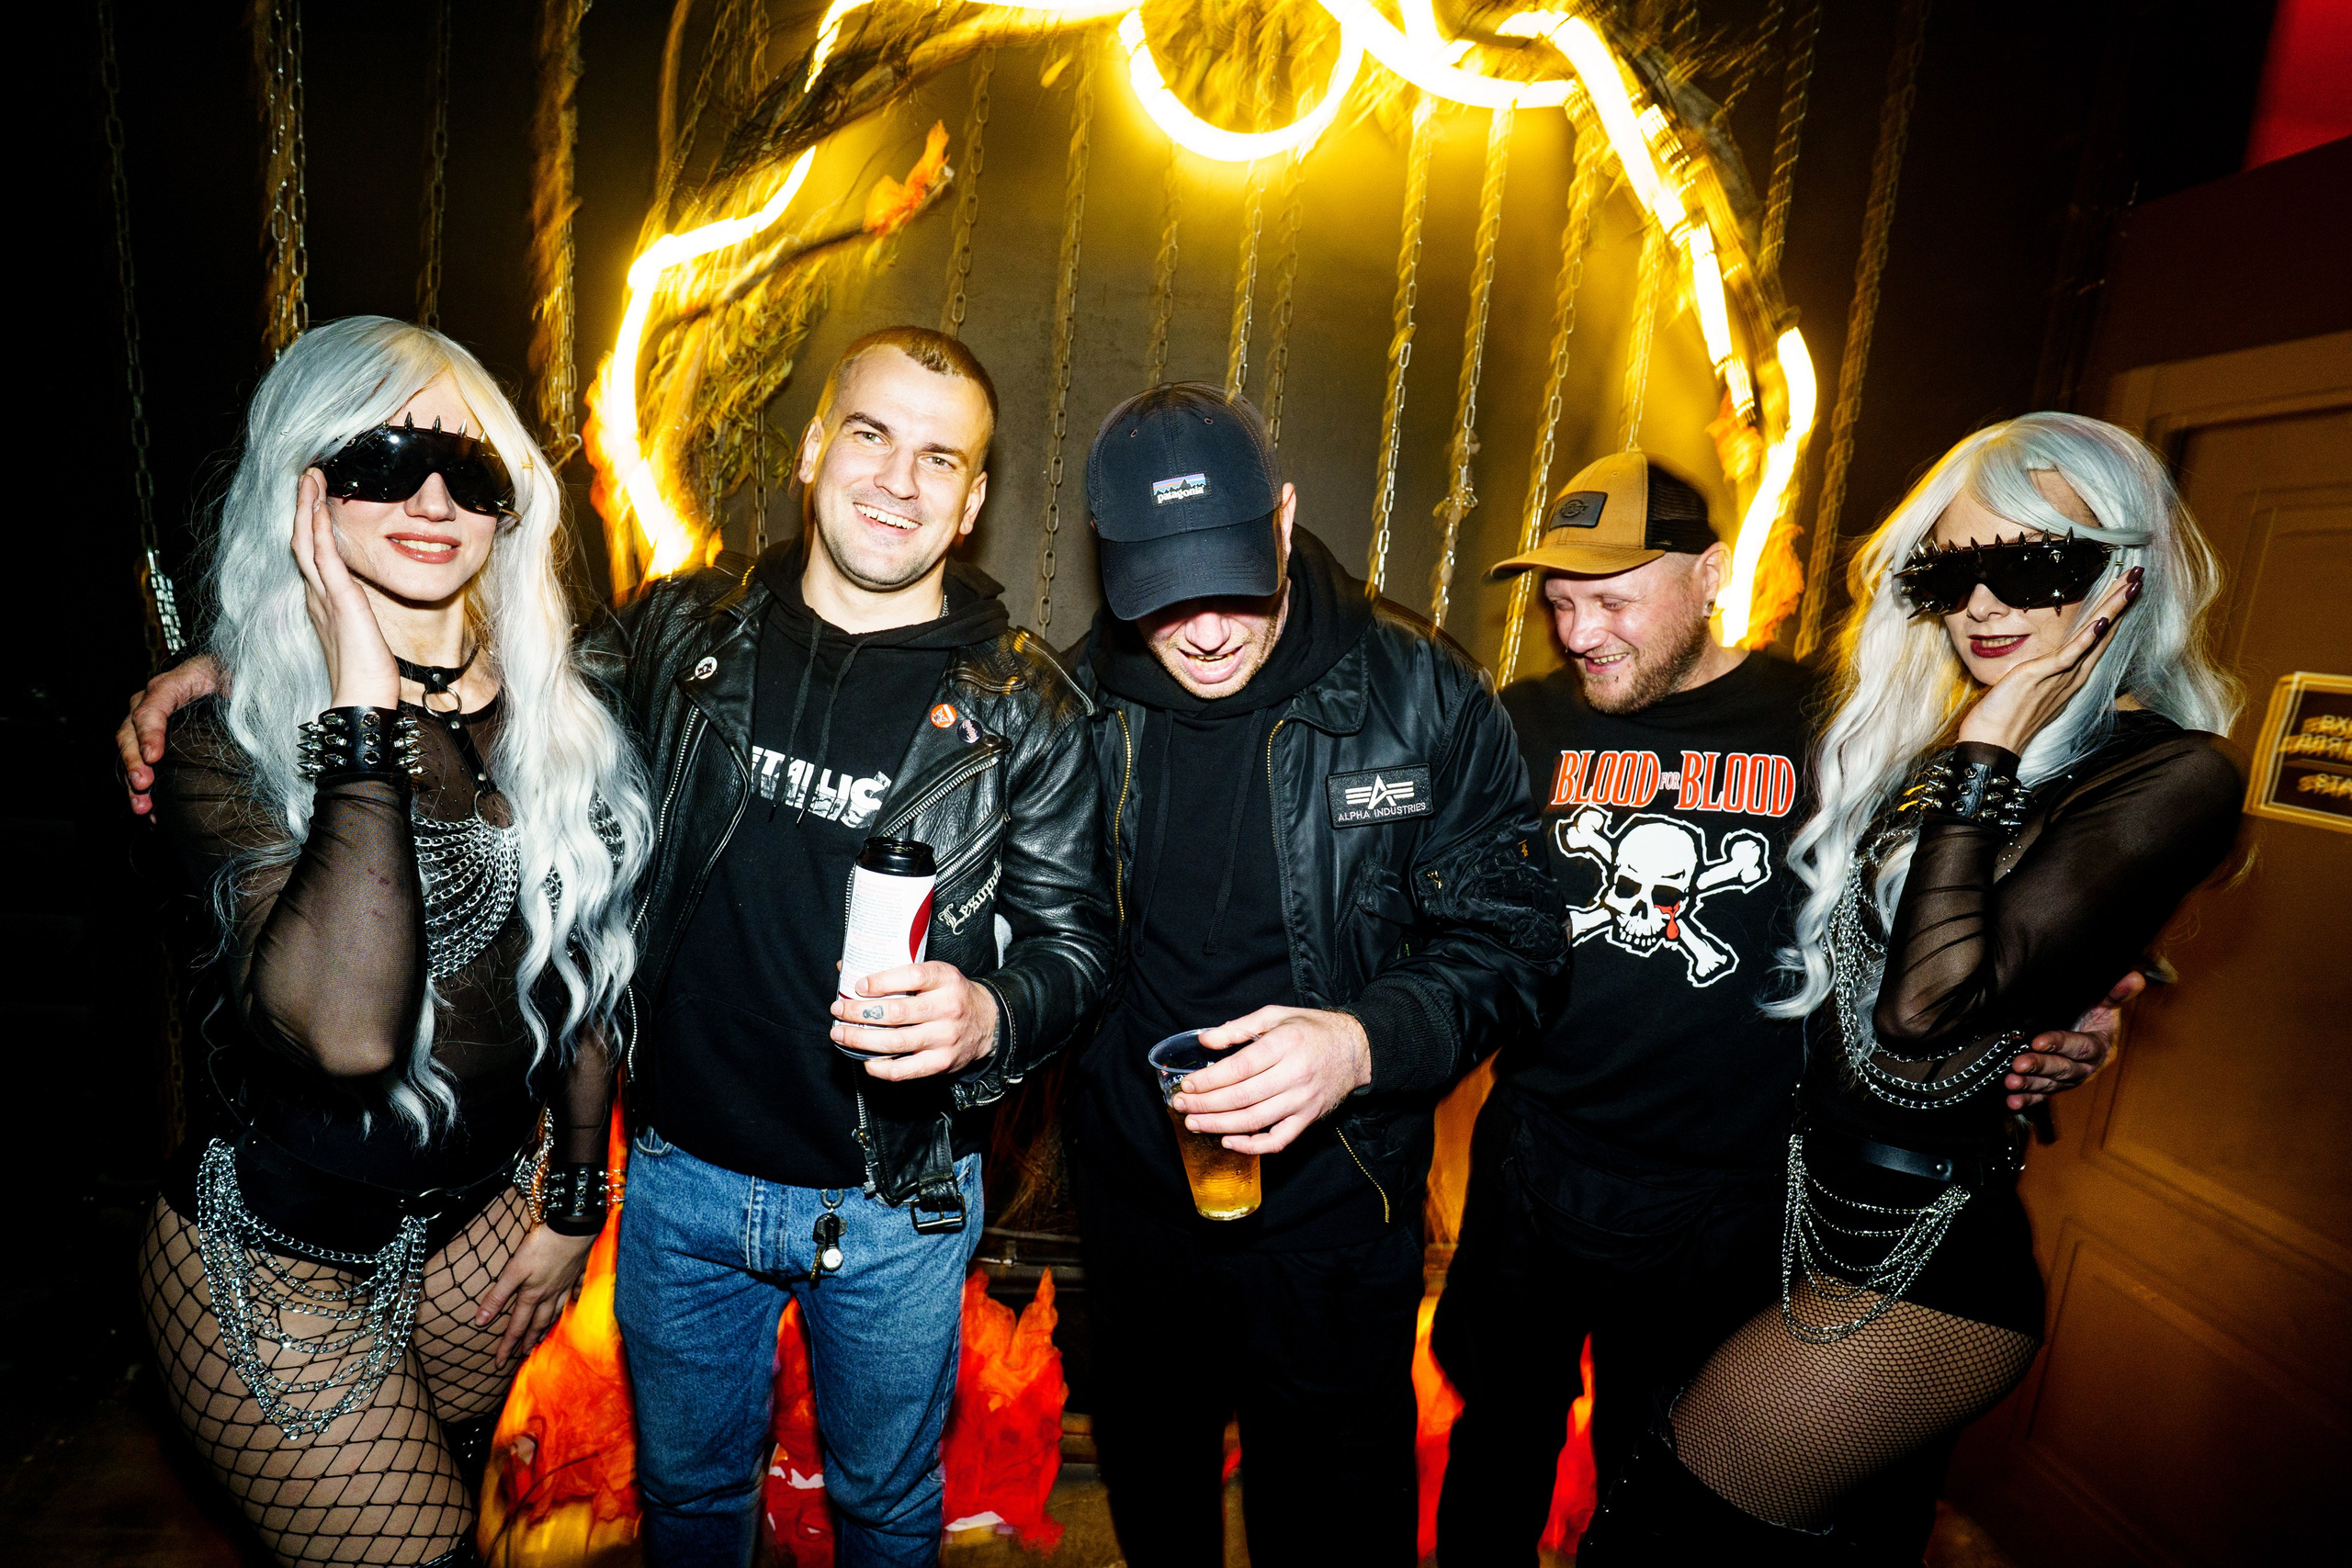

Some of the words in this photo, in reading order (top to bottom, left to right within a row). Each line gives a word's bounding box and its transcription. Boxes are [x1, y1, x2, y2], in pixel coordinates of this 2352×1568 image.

[1158, 485, 1205, 504] patagonia
[1551, 750, 1661, 807] BLOOD
[1659, 772, 1680, 790] FOR
[1674, 750, 1796, 818] BLOOD
[1338, 810, 1371, 822] ALPHA
[1374, 802, 1427, 818] INDUSTRIES
